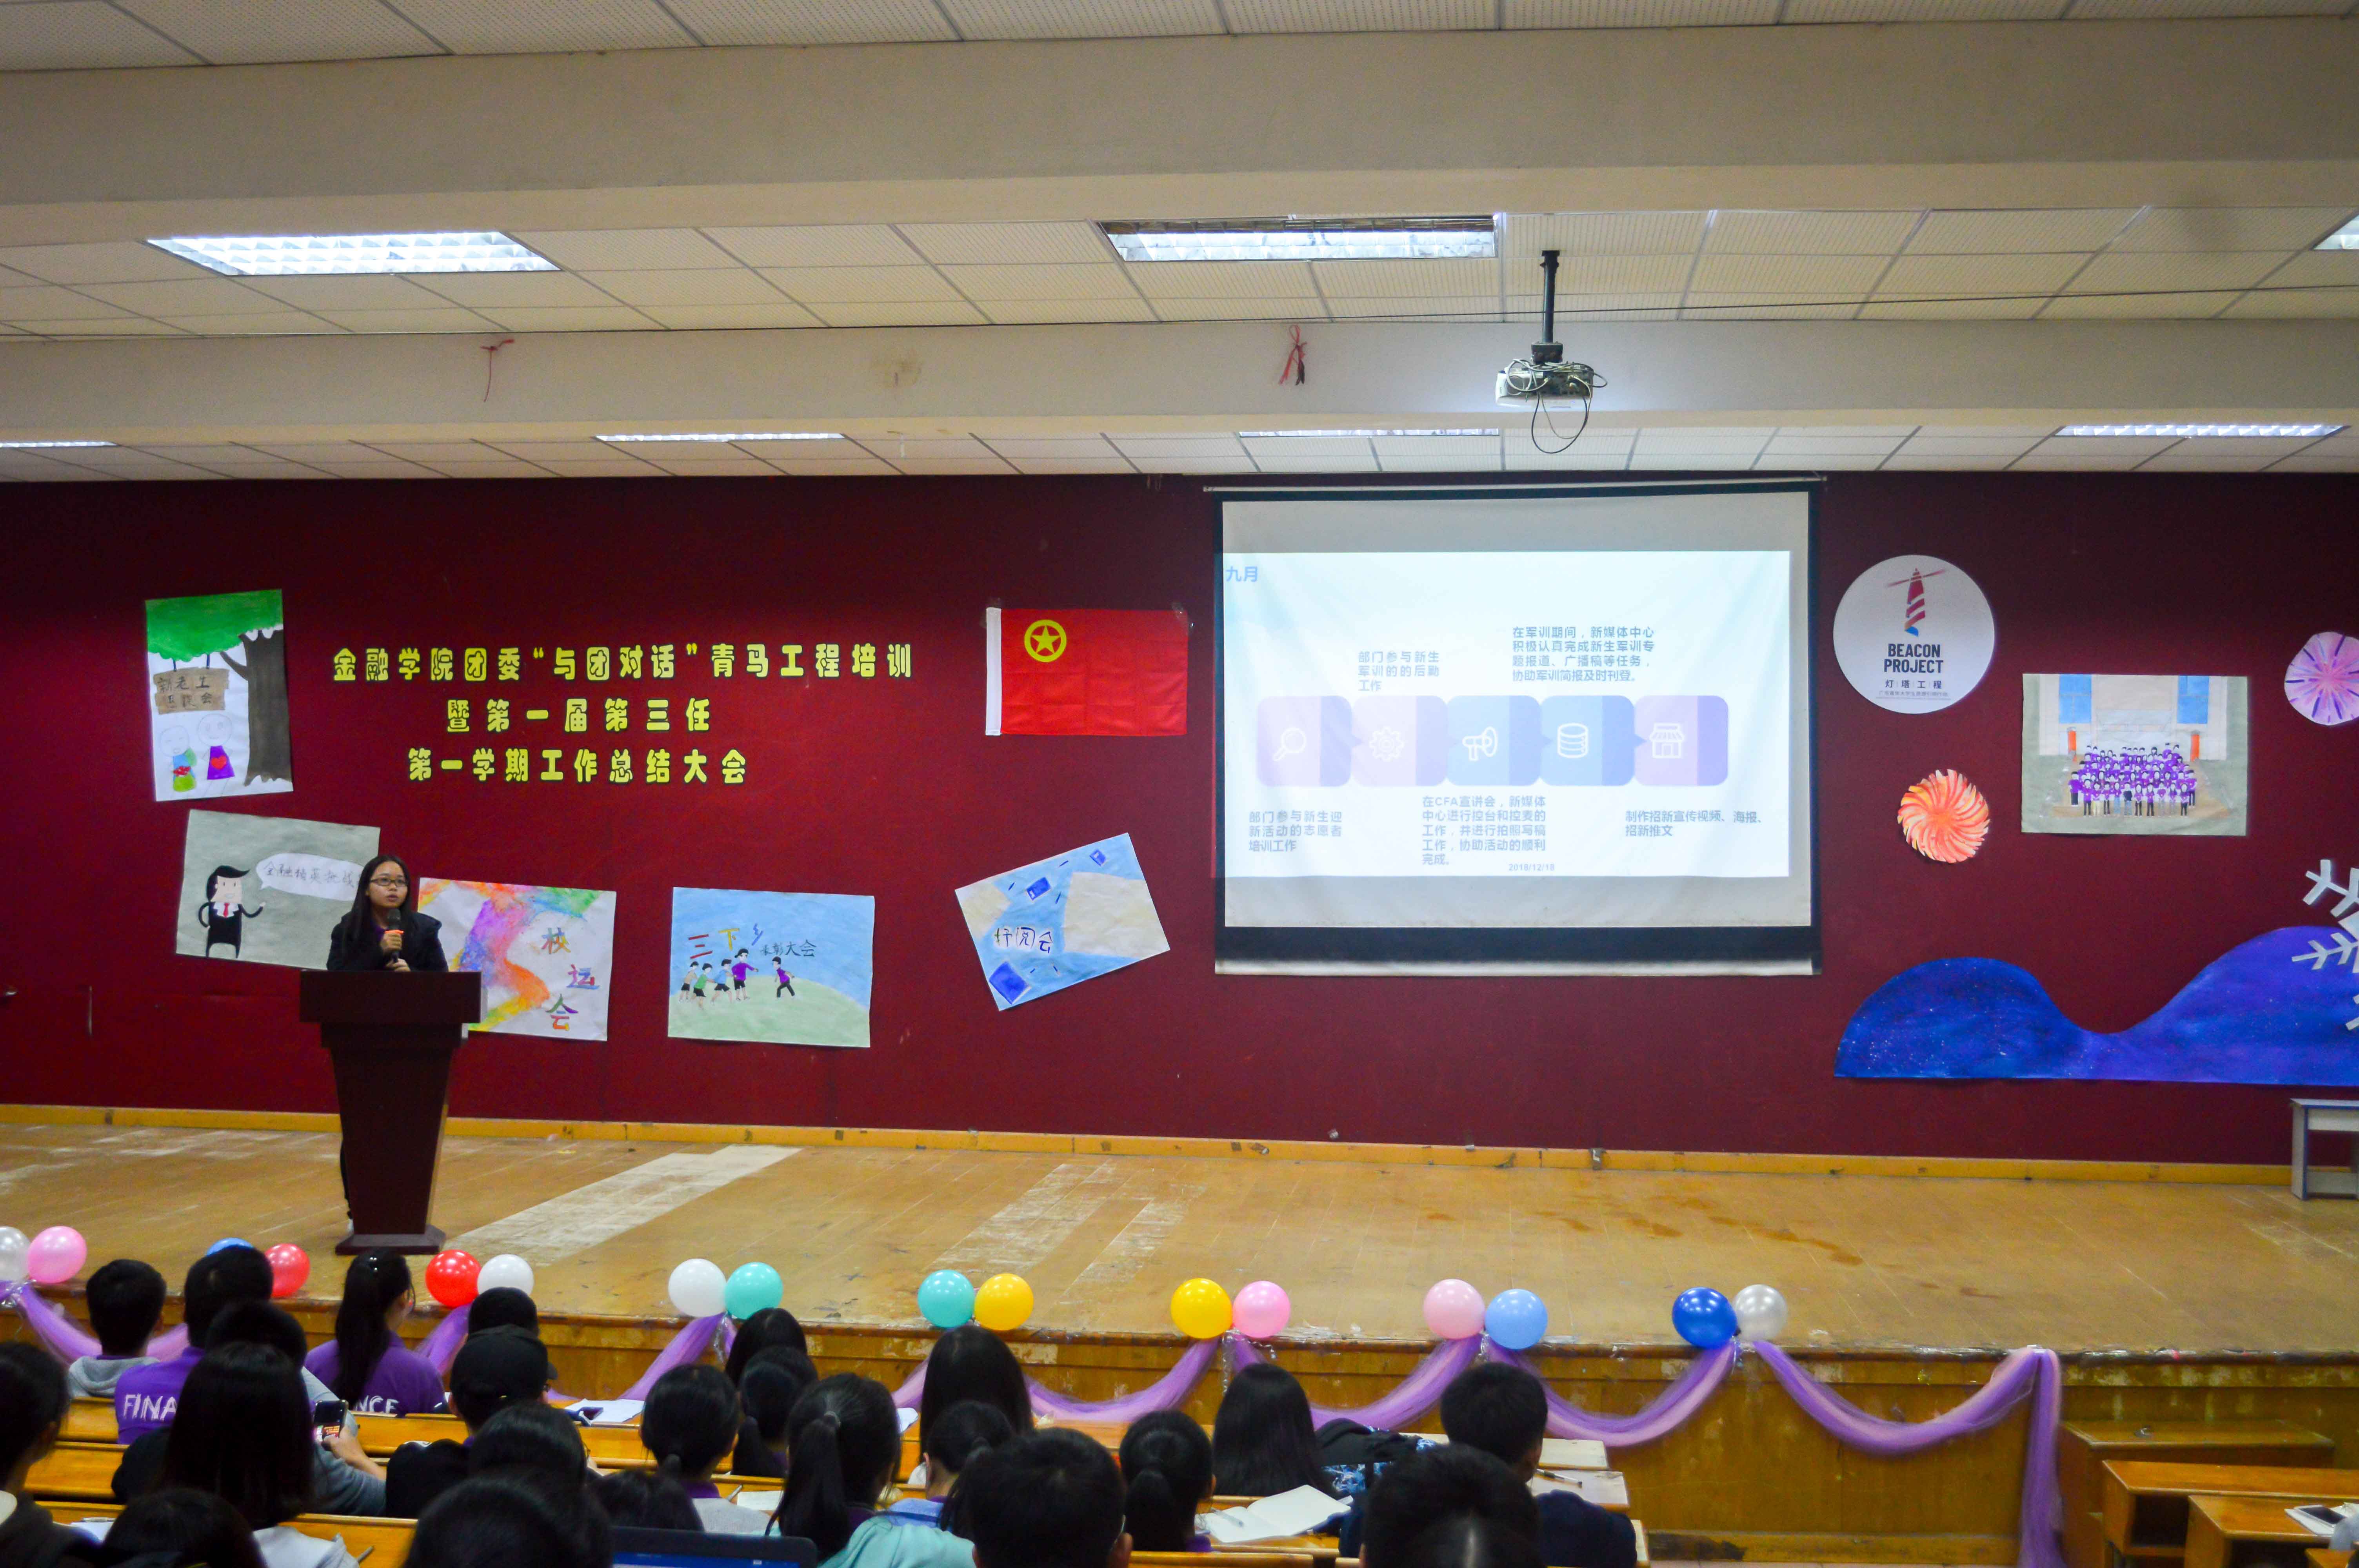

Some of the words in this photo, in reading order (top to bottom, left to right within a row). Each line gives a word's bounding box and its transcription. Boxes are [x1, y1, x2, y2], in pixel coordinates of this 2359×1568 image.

[1226, 566, 1258, 582] 九月
[1512, 626, 1655, 639] 在军训期间，新媒体中心
[1512, 640, 1655, 653] 积极认真完成新生军训专
[1888, 643, 1941, 658] BEACON
[1358, 650, 1440, 663] 部门参与新生
[1512, 655, 1650, 667] 题报道、广播稿等任务，
[1358, 665, 1440, 677] 军训的的后勤
[1884, 659, 1944, 674] PROJECT
[1512, 669, 1636, 682] 协助军训简报及时刊登。
[1358, 679, 1382, 691] 工作
[1885, 680, 1942, 689] 灯塔工程
[447, 698, 710, 733] 暨第一届第三任
[409, 748, 746, 784] 第一学期工作总结大会
[1249, 809, 1343, 823] 部门参与新生迎
[1422, 809, 1547, 822] 中心进行控台和控麦的
[1249, 824, 1343, 838] 新活动的志愿者
[1422, 824, 1547, 837] 工作，并进行拍照写稿
[1625, 824, 1674, 837] 招新推文
[1249, 839, 1297, 852] 培训工作
[1422, 839, 1547, 851] 工作，协助活动的顺利
[1422, 853, 1450, 866] 完成。
[1508, 863, 1555, 871] 2018/12/18
[264, 861, 362, 889] 金融精英挑战
[123, 1393, 178, 1421] FINA
